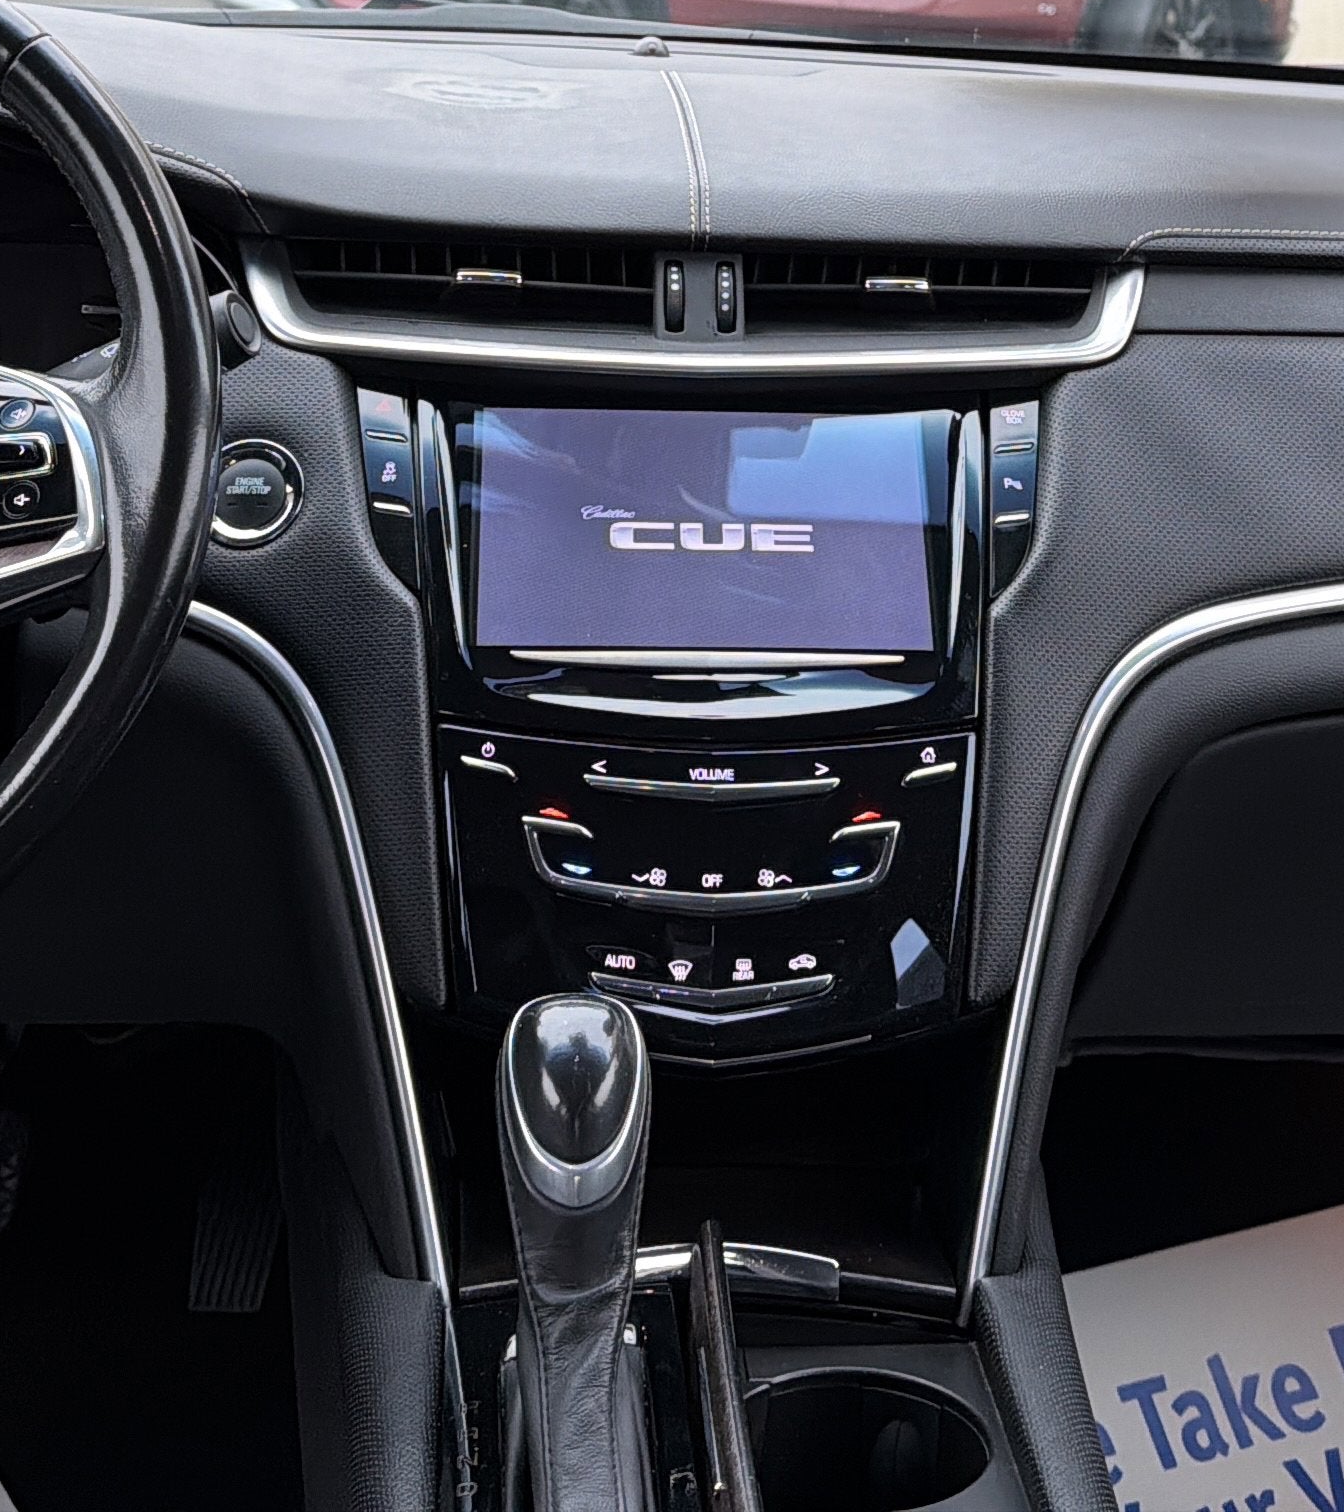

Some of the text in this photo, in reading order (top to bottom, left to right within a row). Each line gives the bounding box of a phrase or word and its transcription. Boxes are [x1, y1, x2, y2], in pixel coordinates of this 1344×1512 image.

[1000, 409, 1026, 419] GLOVE
[235, 477, 265, 486] ENGINE
[226, 486, 272, 495] START/STOP
[580, 505, 637, 521] Cadillac
[609, 521, 815, 553] CUE
[689, 767, 735, 782] VOLUME
[701, 873, 724, 888] OFF
[604, 954, 636, 970] AUTO
[732, 968, 755, 981] REAR
[1117, 1353, 1327, 1471] Take
